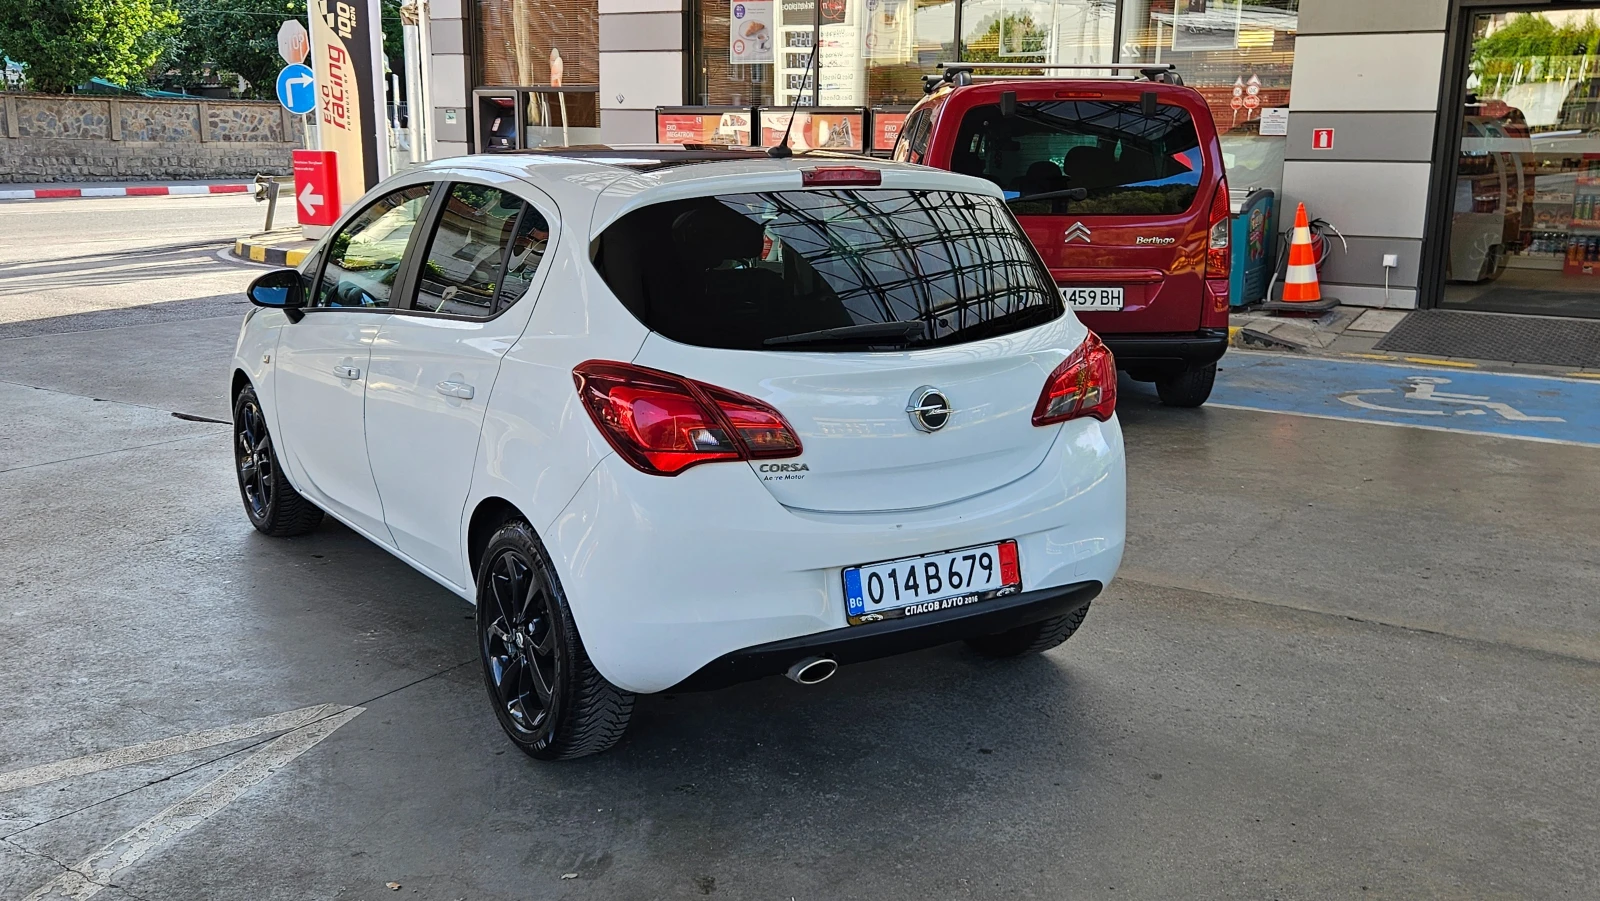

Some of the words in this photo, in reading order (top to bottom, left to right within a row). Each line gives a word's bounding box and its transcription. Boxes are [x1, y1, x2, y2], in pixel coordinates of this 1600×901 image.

[336, 1, 352, 39] 100
[349, 5, 357, 28] RON
[327, 44, 346, 130] racing
[344, 89, 352, 132] FORMULA
[1136, 236, 1175, 245] Berlingo
[1100, 289, 1121, 306] BH
[759, 463, 810, 473] CORSA
[867, 552, 993, 604] 014B679
[849, 596, 863, 608] BG
[905, 601, 940, 616] СПАСОВ
[941, 596, 963, 609] АУТО
[964, 595, 979, 604] 2016
